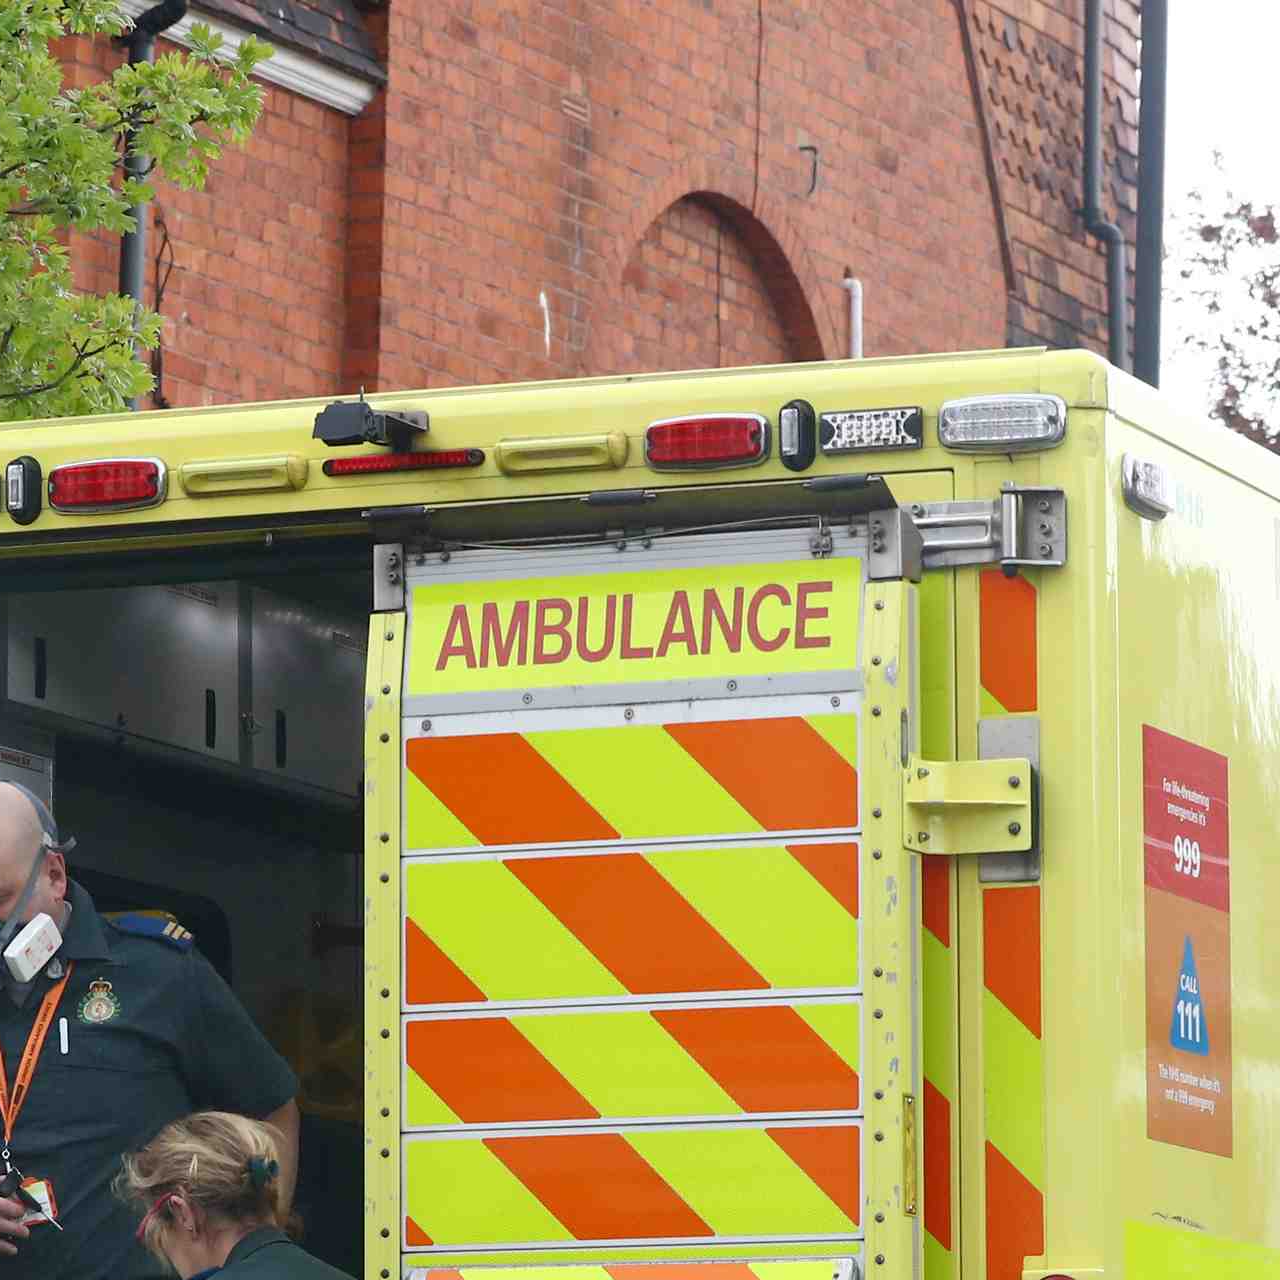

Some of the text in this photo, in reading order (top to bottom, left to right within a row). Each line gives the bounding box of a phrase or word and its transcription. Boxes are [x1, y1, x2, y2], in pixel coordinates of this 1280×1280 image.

[435, 581, 834, 671] AMBULANCE
[1174, 835, 1201, 877] 999
[1180, 974, 1198, 994] CALL
[1177, 999, 1200, 1042] 111
